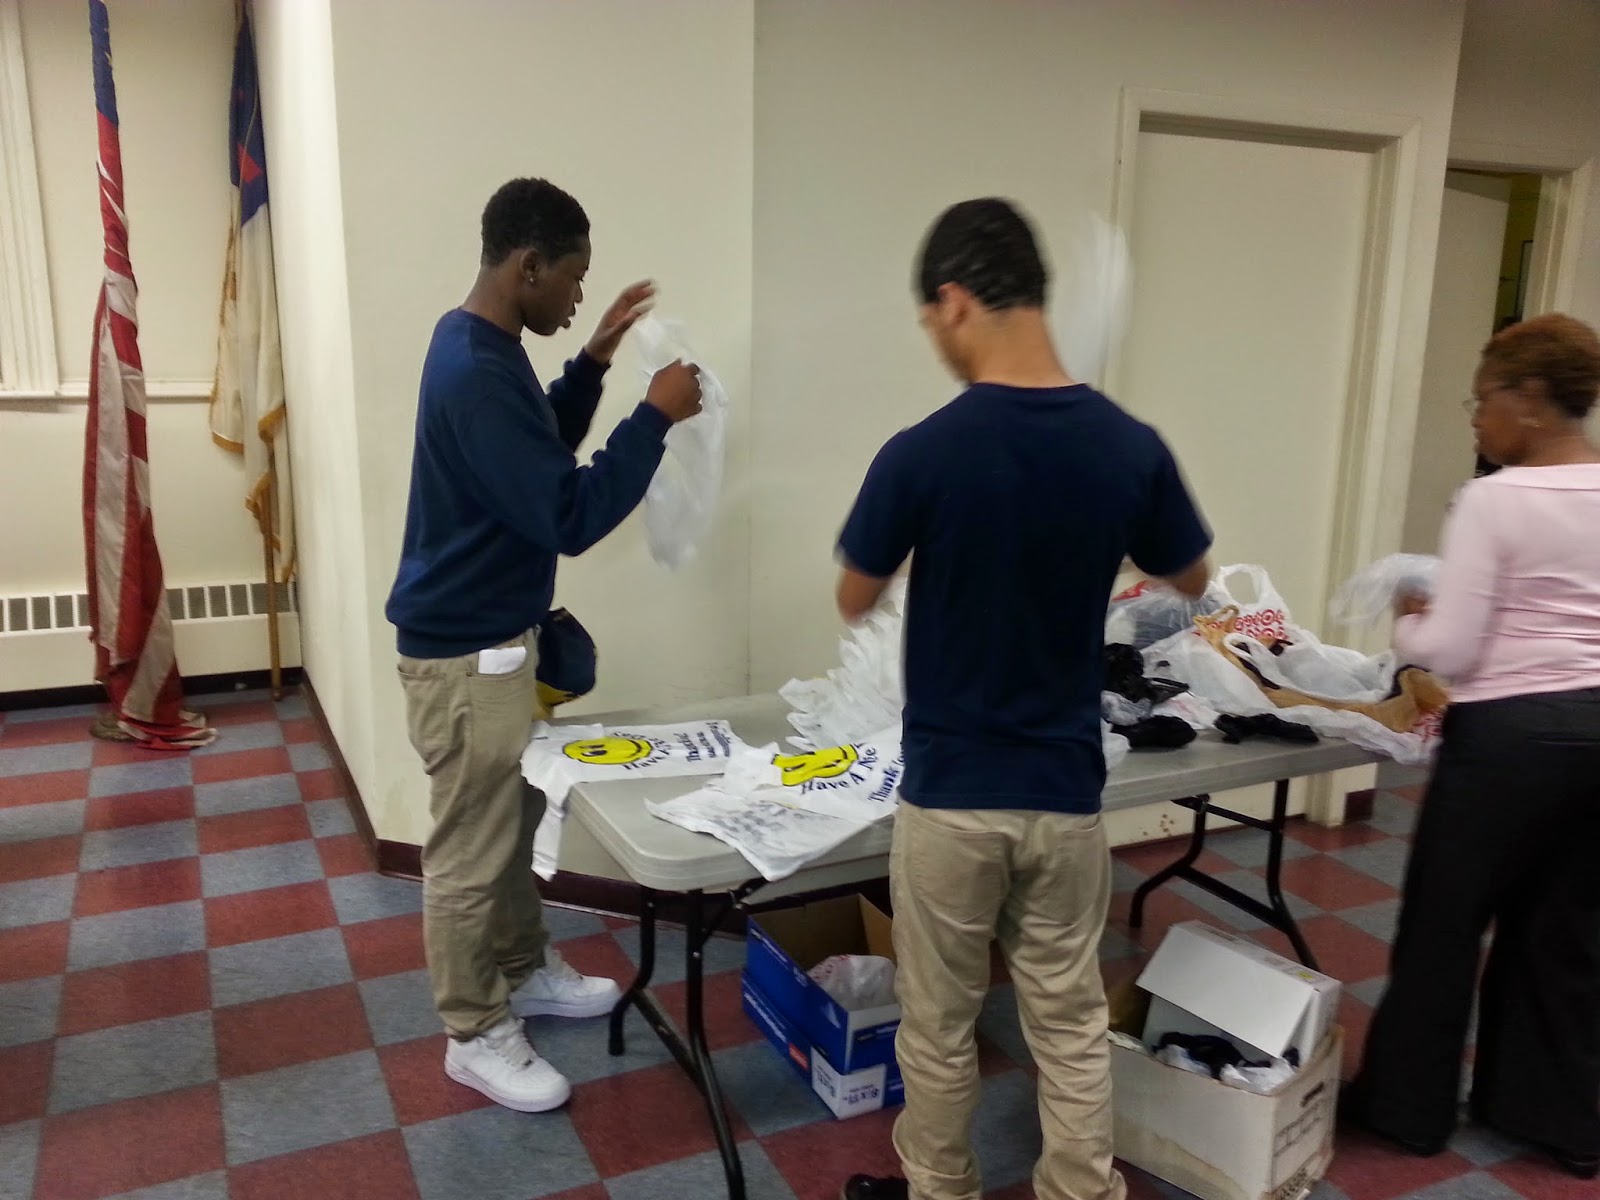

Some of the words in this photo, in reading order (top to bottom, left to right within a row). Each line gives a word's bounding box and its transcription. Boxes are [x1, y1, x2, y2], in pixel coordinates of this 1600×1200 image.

[801, 778, 850, 795] Have
[849, 771, 865, 786] A
[867, 766, 900, 802] Thank
